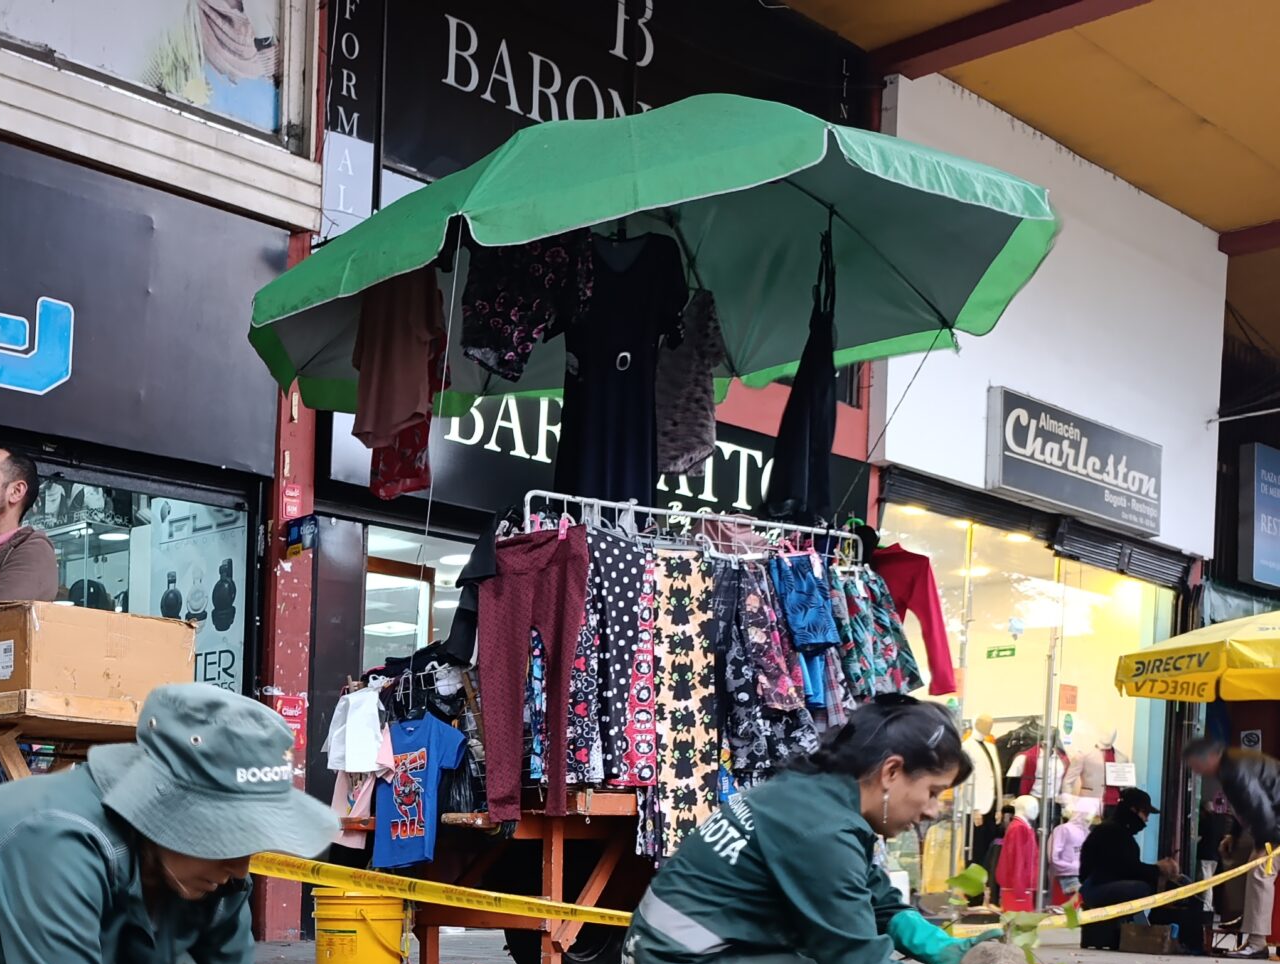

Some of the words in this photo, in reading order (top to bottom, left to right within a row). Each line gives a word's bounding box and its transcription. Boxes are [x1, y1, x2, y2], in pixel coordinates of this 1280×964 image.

[1039, 412, 1081, 442] Almacén
[1005, 408, 1158, 499] Charleston
[1132, 652, 1211, 678] DIRECTV
